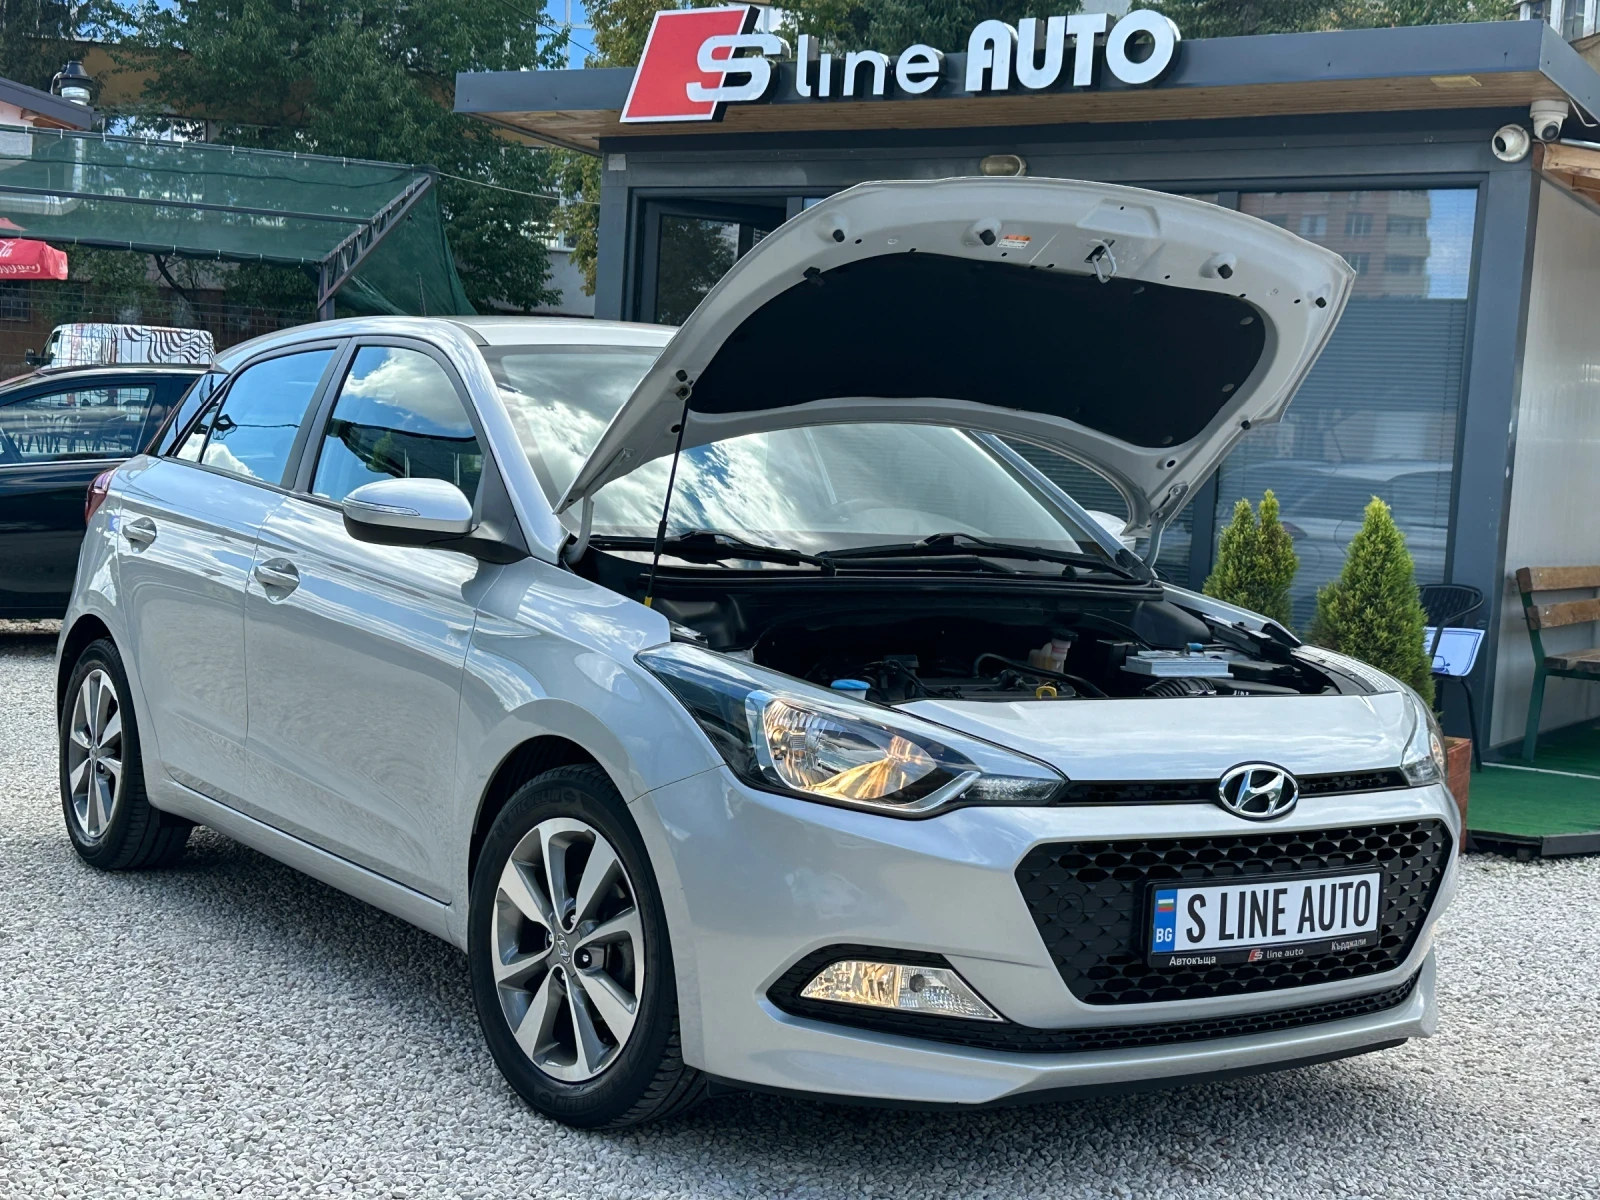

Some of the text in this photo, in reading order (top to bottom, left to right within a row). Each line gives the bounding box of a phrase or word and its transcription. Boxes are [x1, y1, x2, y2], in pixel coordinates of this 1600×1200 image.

[686, 9, 1177, 102] S line AUTO
[1186, 879, 1371, 943] S LINE AUTO
[1156, 927, 1173, 943] BG
[1168, 955, 1217, 967] Автокъща
[1266, 949, 1283, 959] line
[1284, 948, 1304, 957] auto
